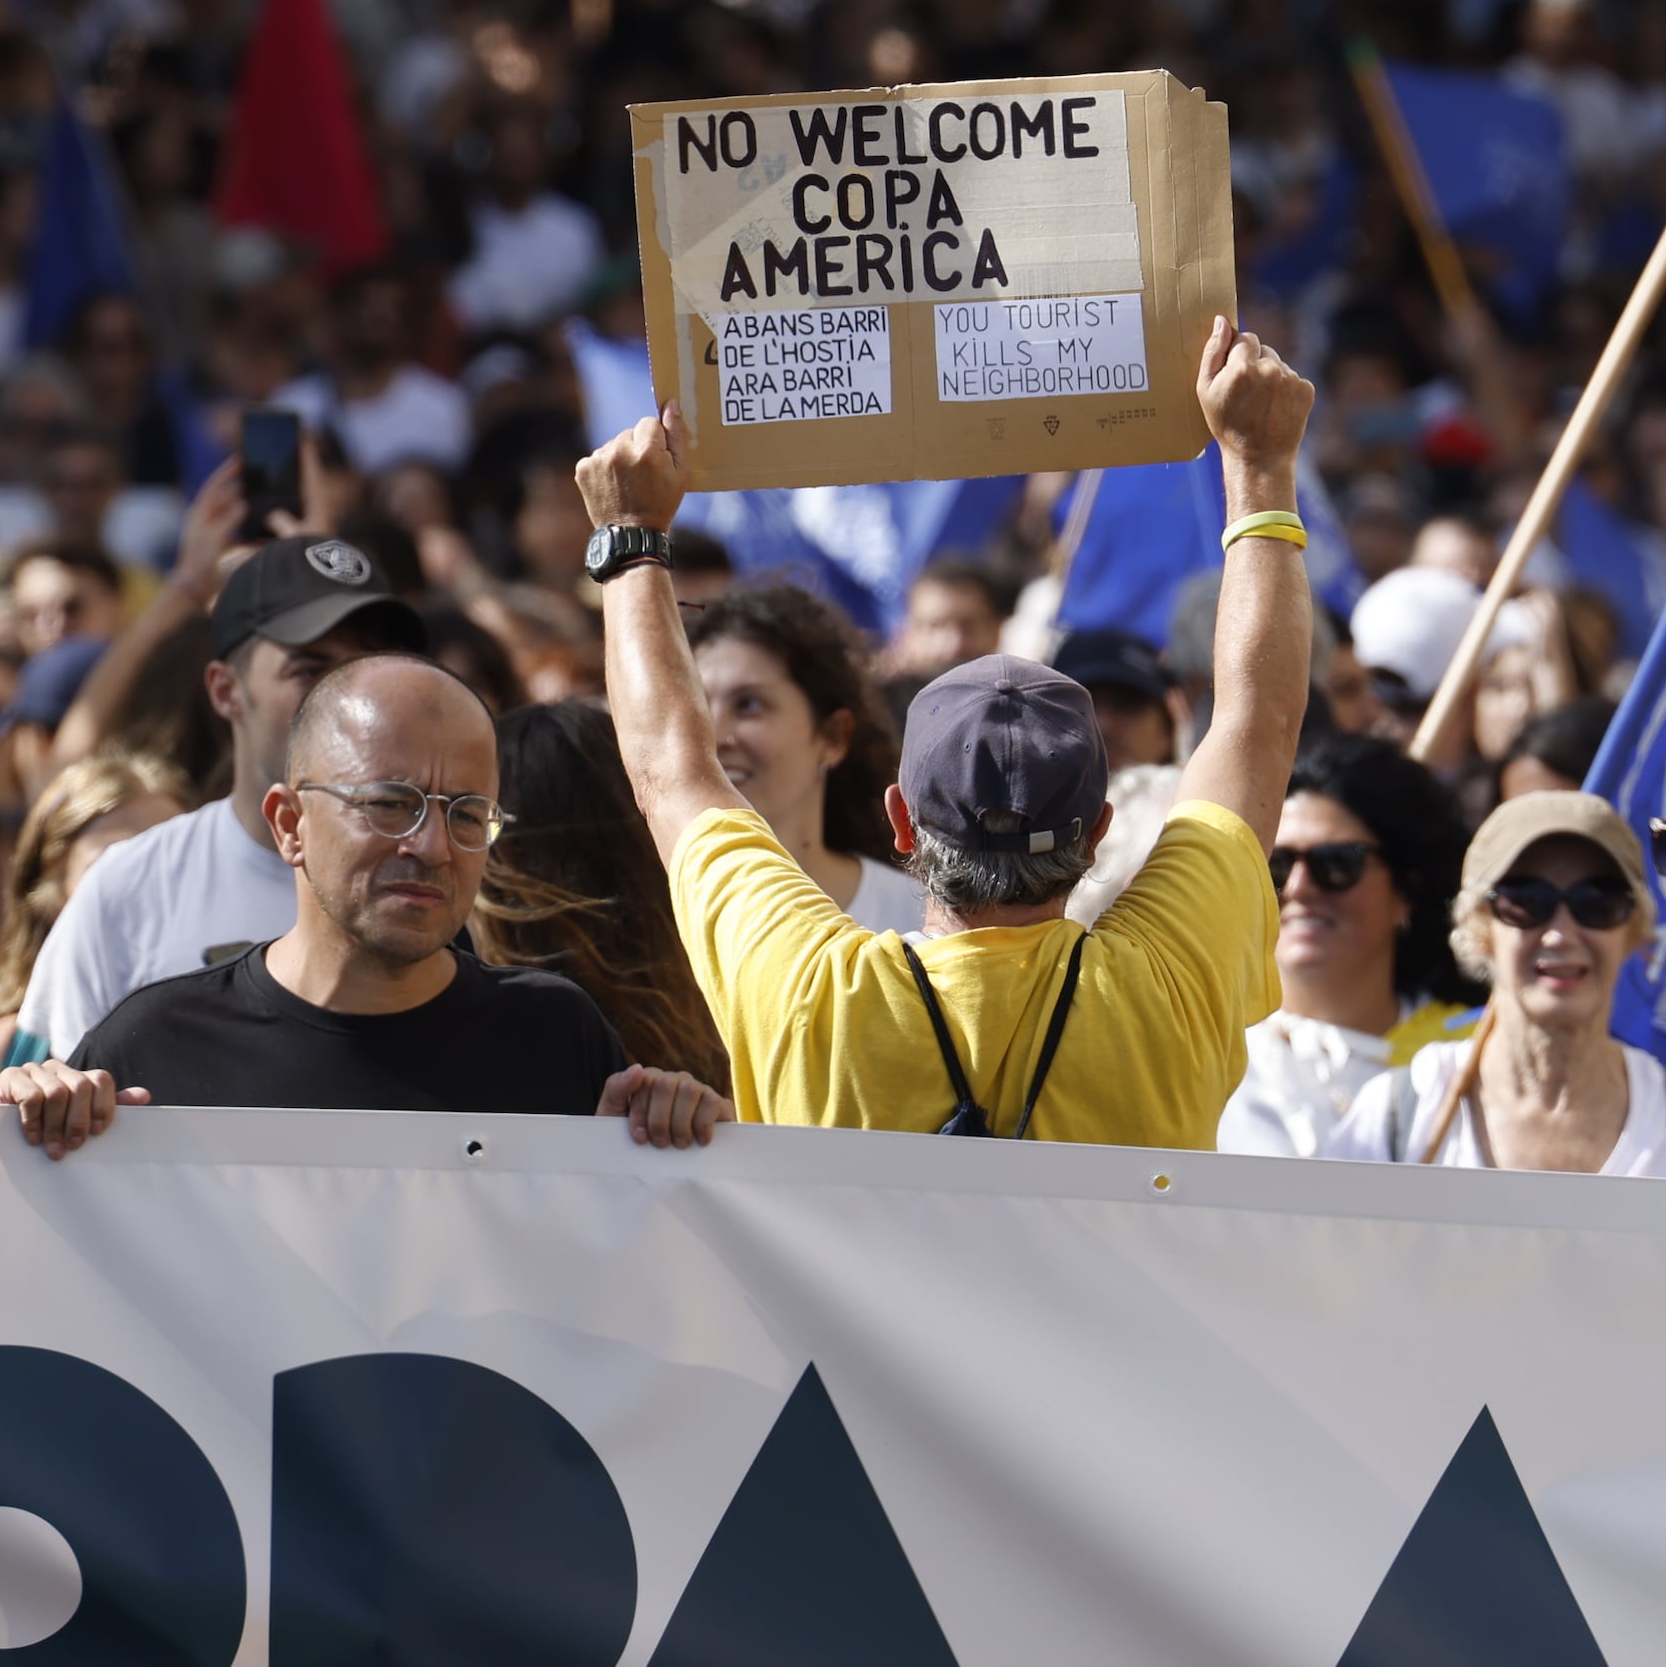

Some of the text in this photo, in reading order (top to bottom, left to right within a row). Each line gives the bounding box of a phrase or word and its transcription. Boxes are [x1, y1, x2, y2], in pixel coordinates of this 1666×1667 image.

[677, 96, 1100, 174] NO WELCOME
[792, 167, 964, 235] COPA
[724, 312, 815, 339] ABANS
[939, 305, 989, 334] YOU
[724, 344, 755, 368] DE
[1058, 337, 1093, 363] MY
[726, 371, 778, 397] ARA
[725, 391, 883, 422] DE LA MERDA
